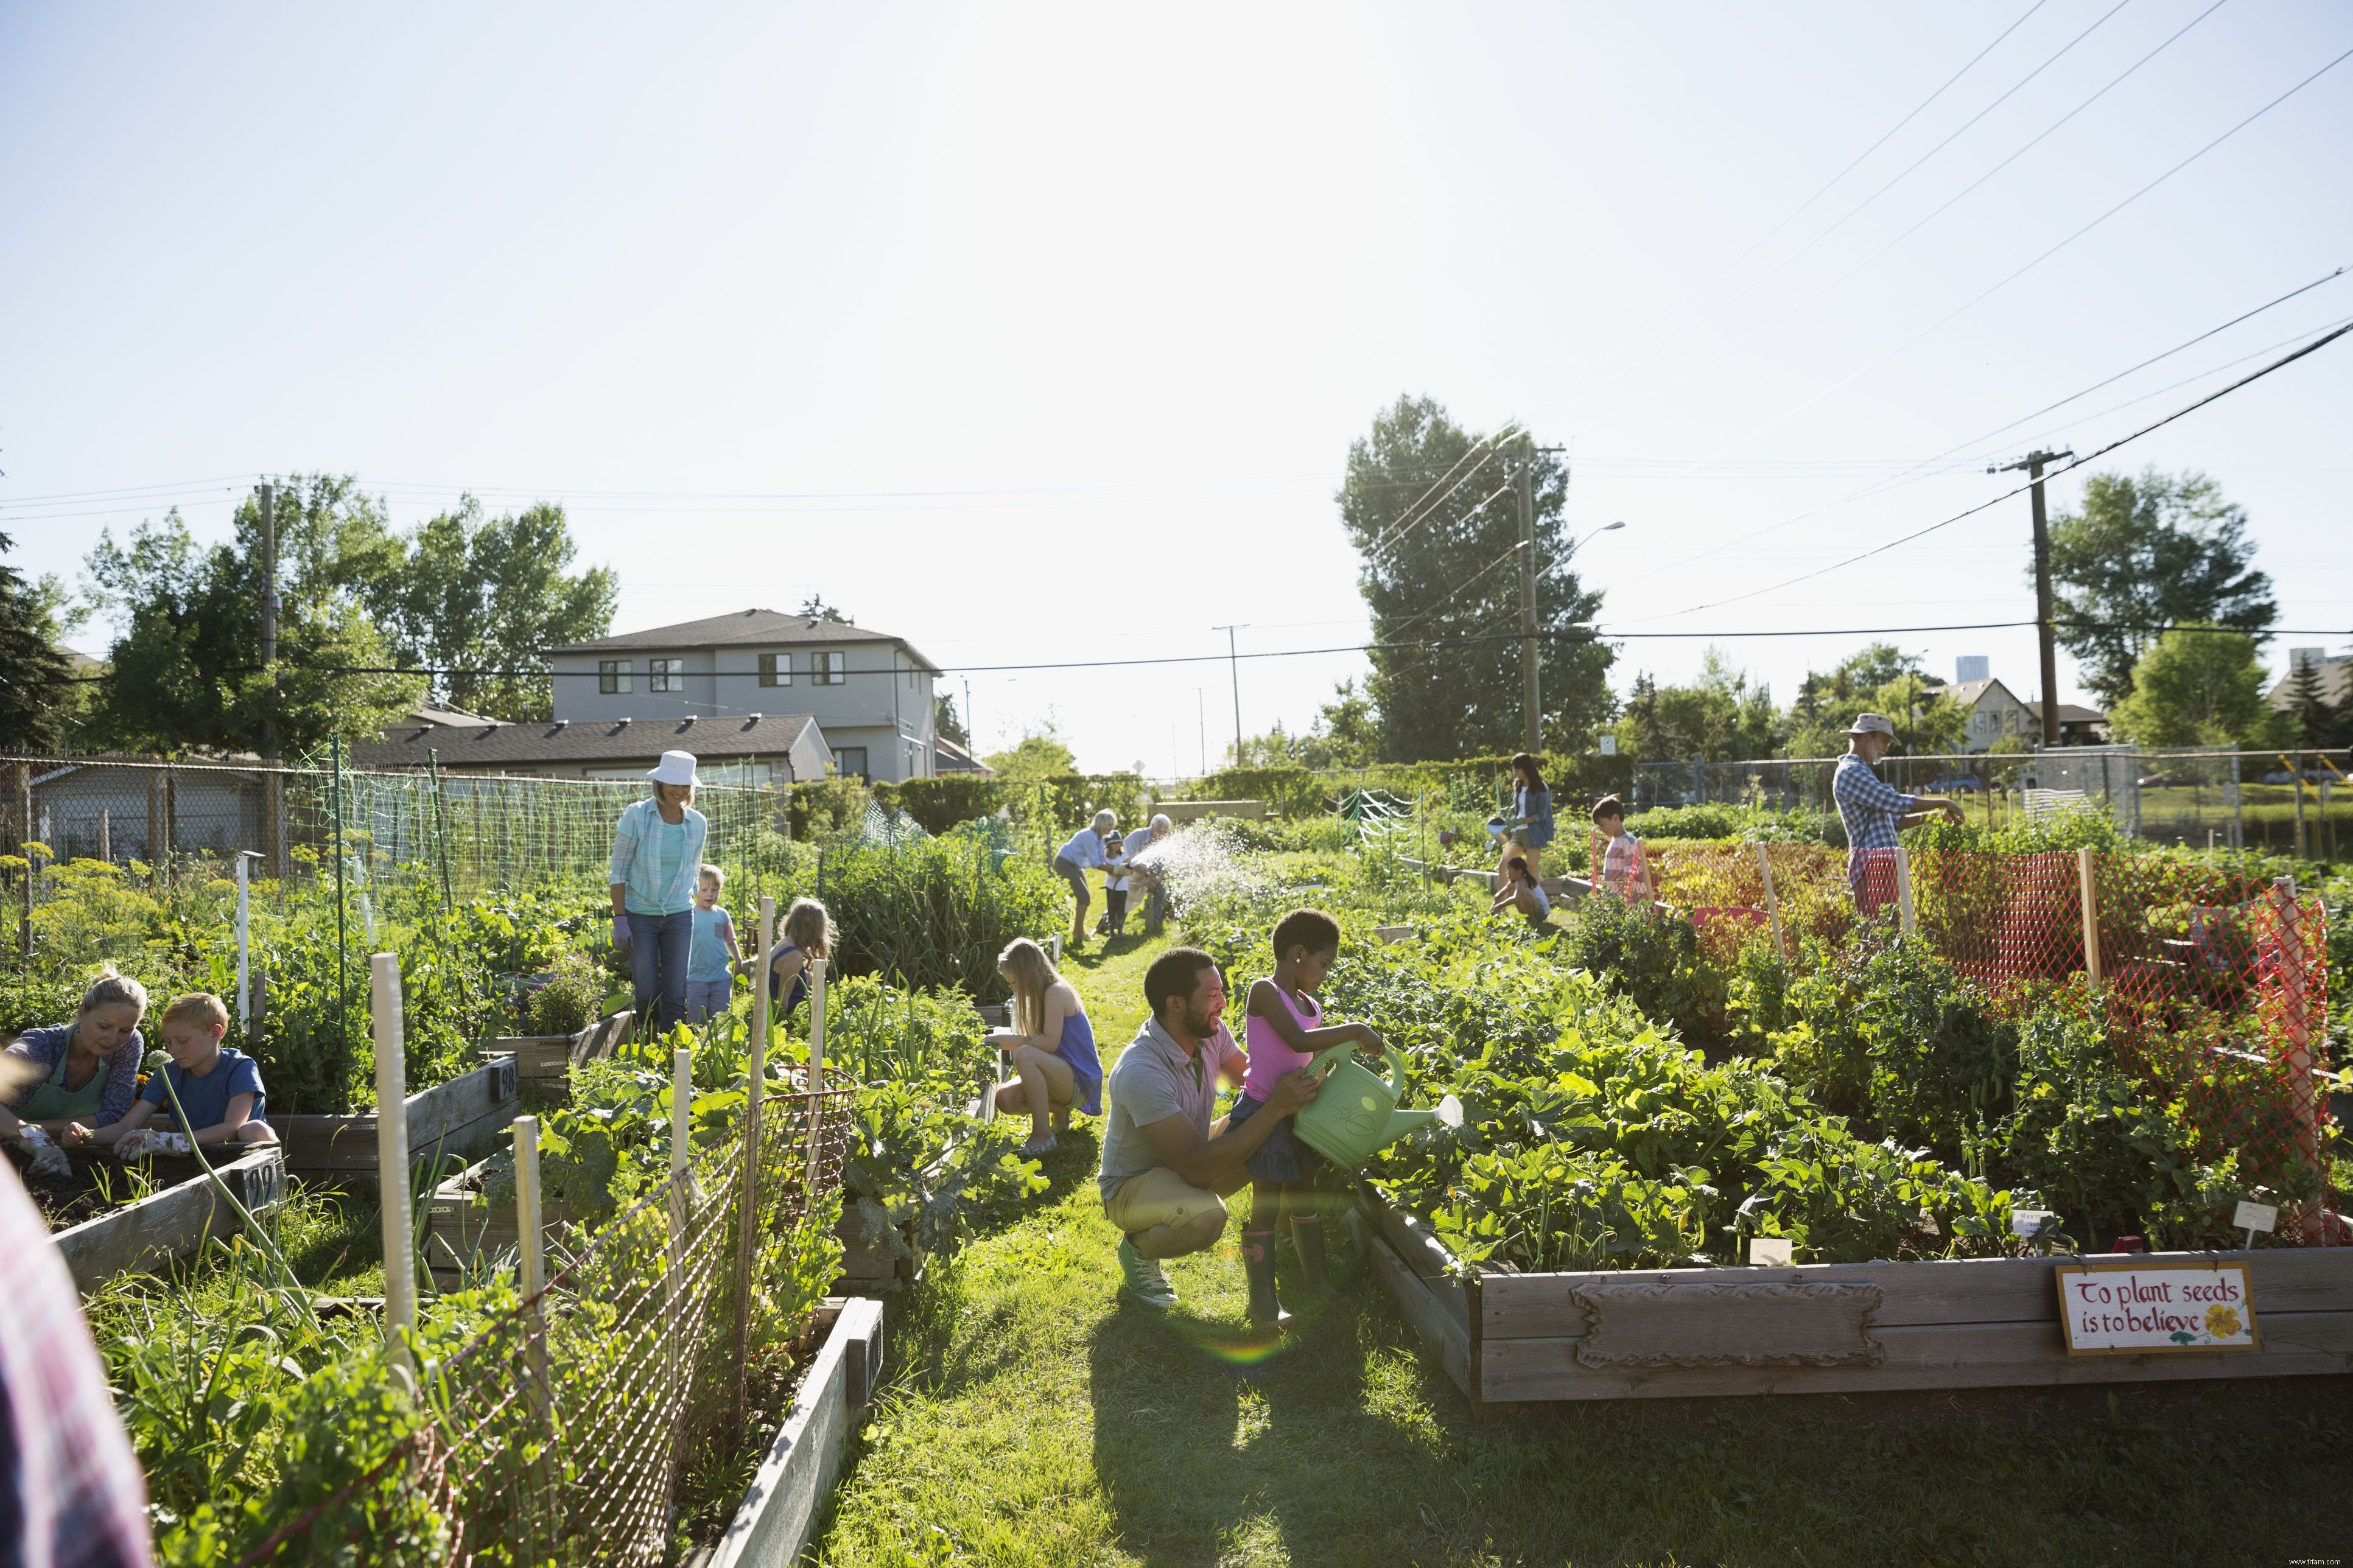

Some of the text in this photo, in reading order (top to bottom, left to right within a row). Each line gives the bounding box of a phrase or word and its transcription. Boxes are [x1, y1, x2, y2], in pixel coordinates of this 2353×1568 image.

[502, 1066, 514, 1097] 98
[250, 1164, 273, 1208] 99
[2075, 1275, 2240, 1311] To plant seeds
[2081, 1306, 2201, 1333] is to believe
